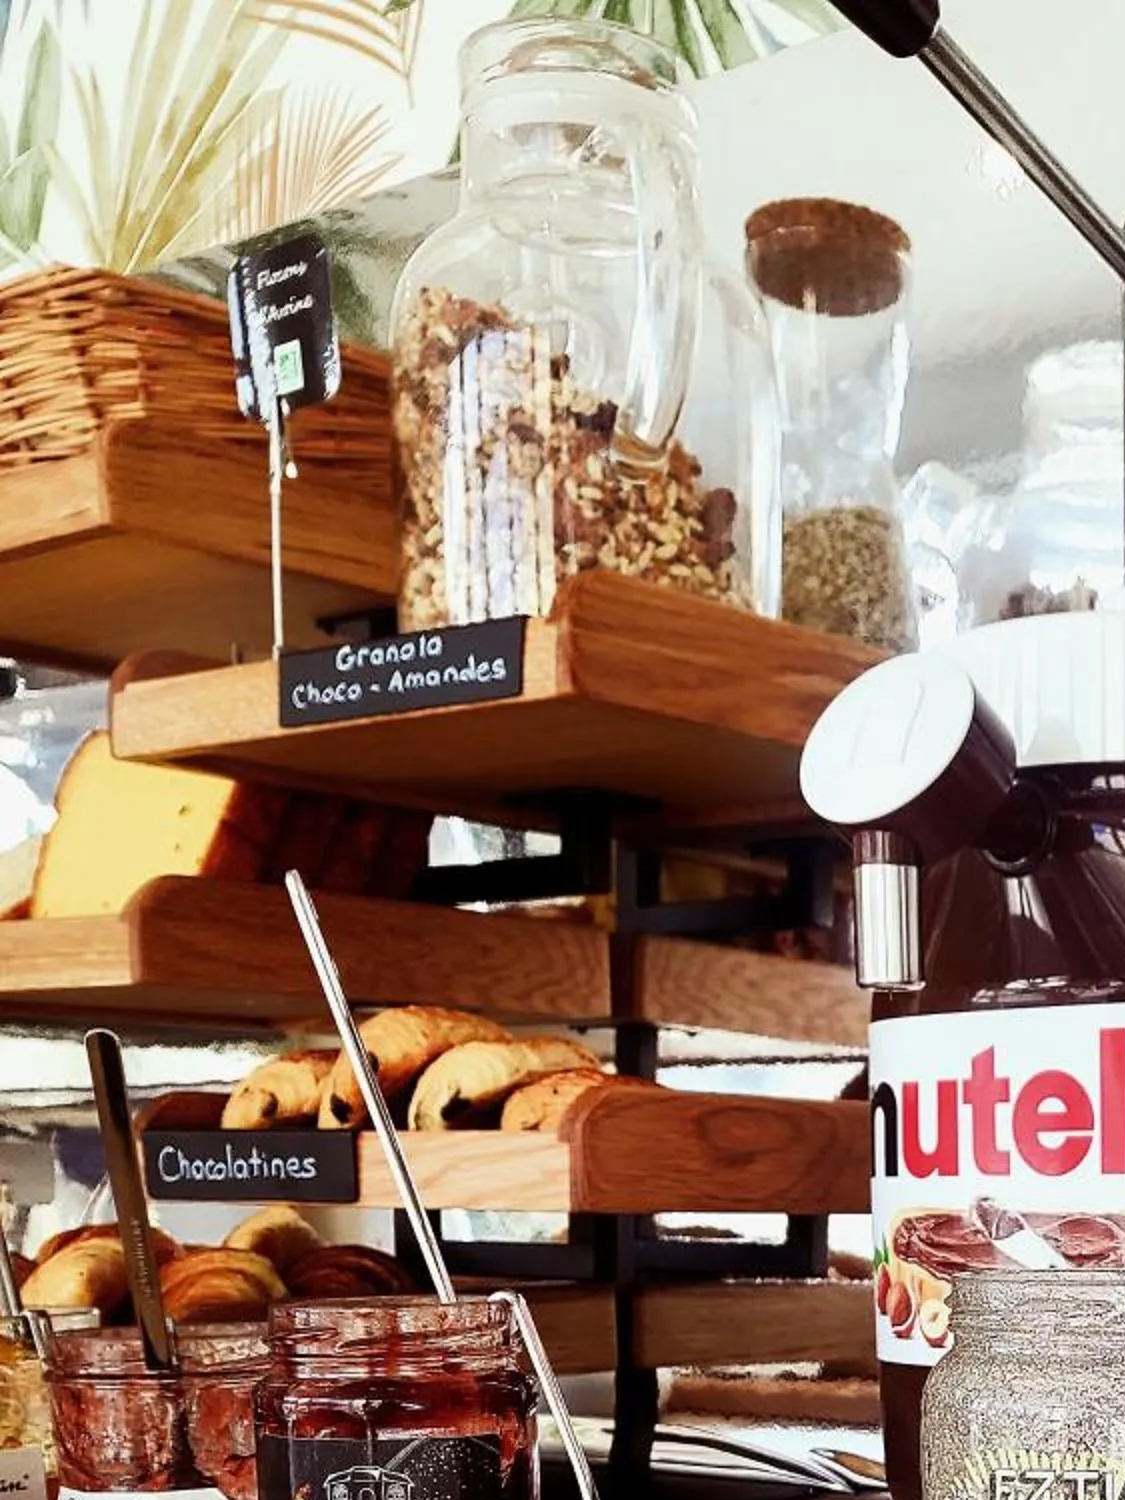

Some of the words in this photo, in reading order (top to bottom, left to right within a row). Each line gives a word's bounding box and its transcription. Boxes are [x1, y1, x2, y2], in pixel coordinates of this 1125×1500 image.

[335, 635, 443, 671] Granola
[291, 681, 363, 709] Choco
[387, 654, 507, 692] Amandes
[158, 1143, 318, 1182] Chocolatines
